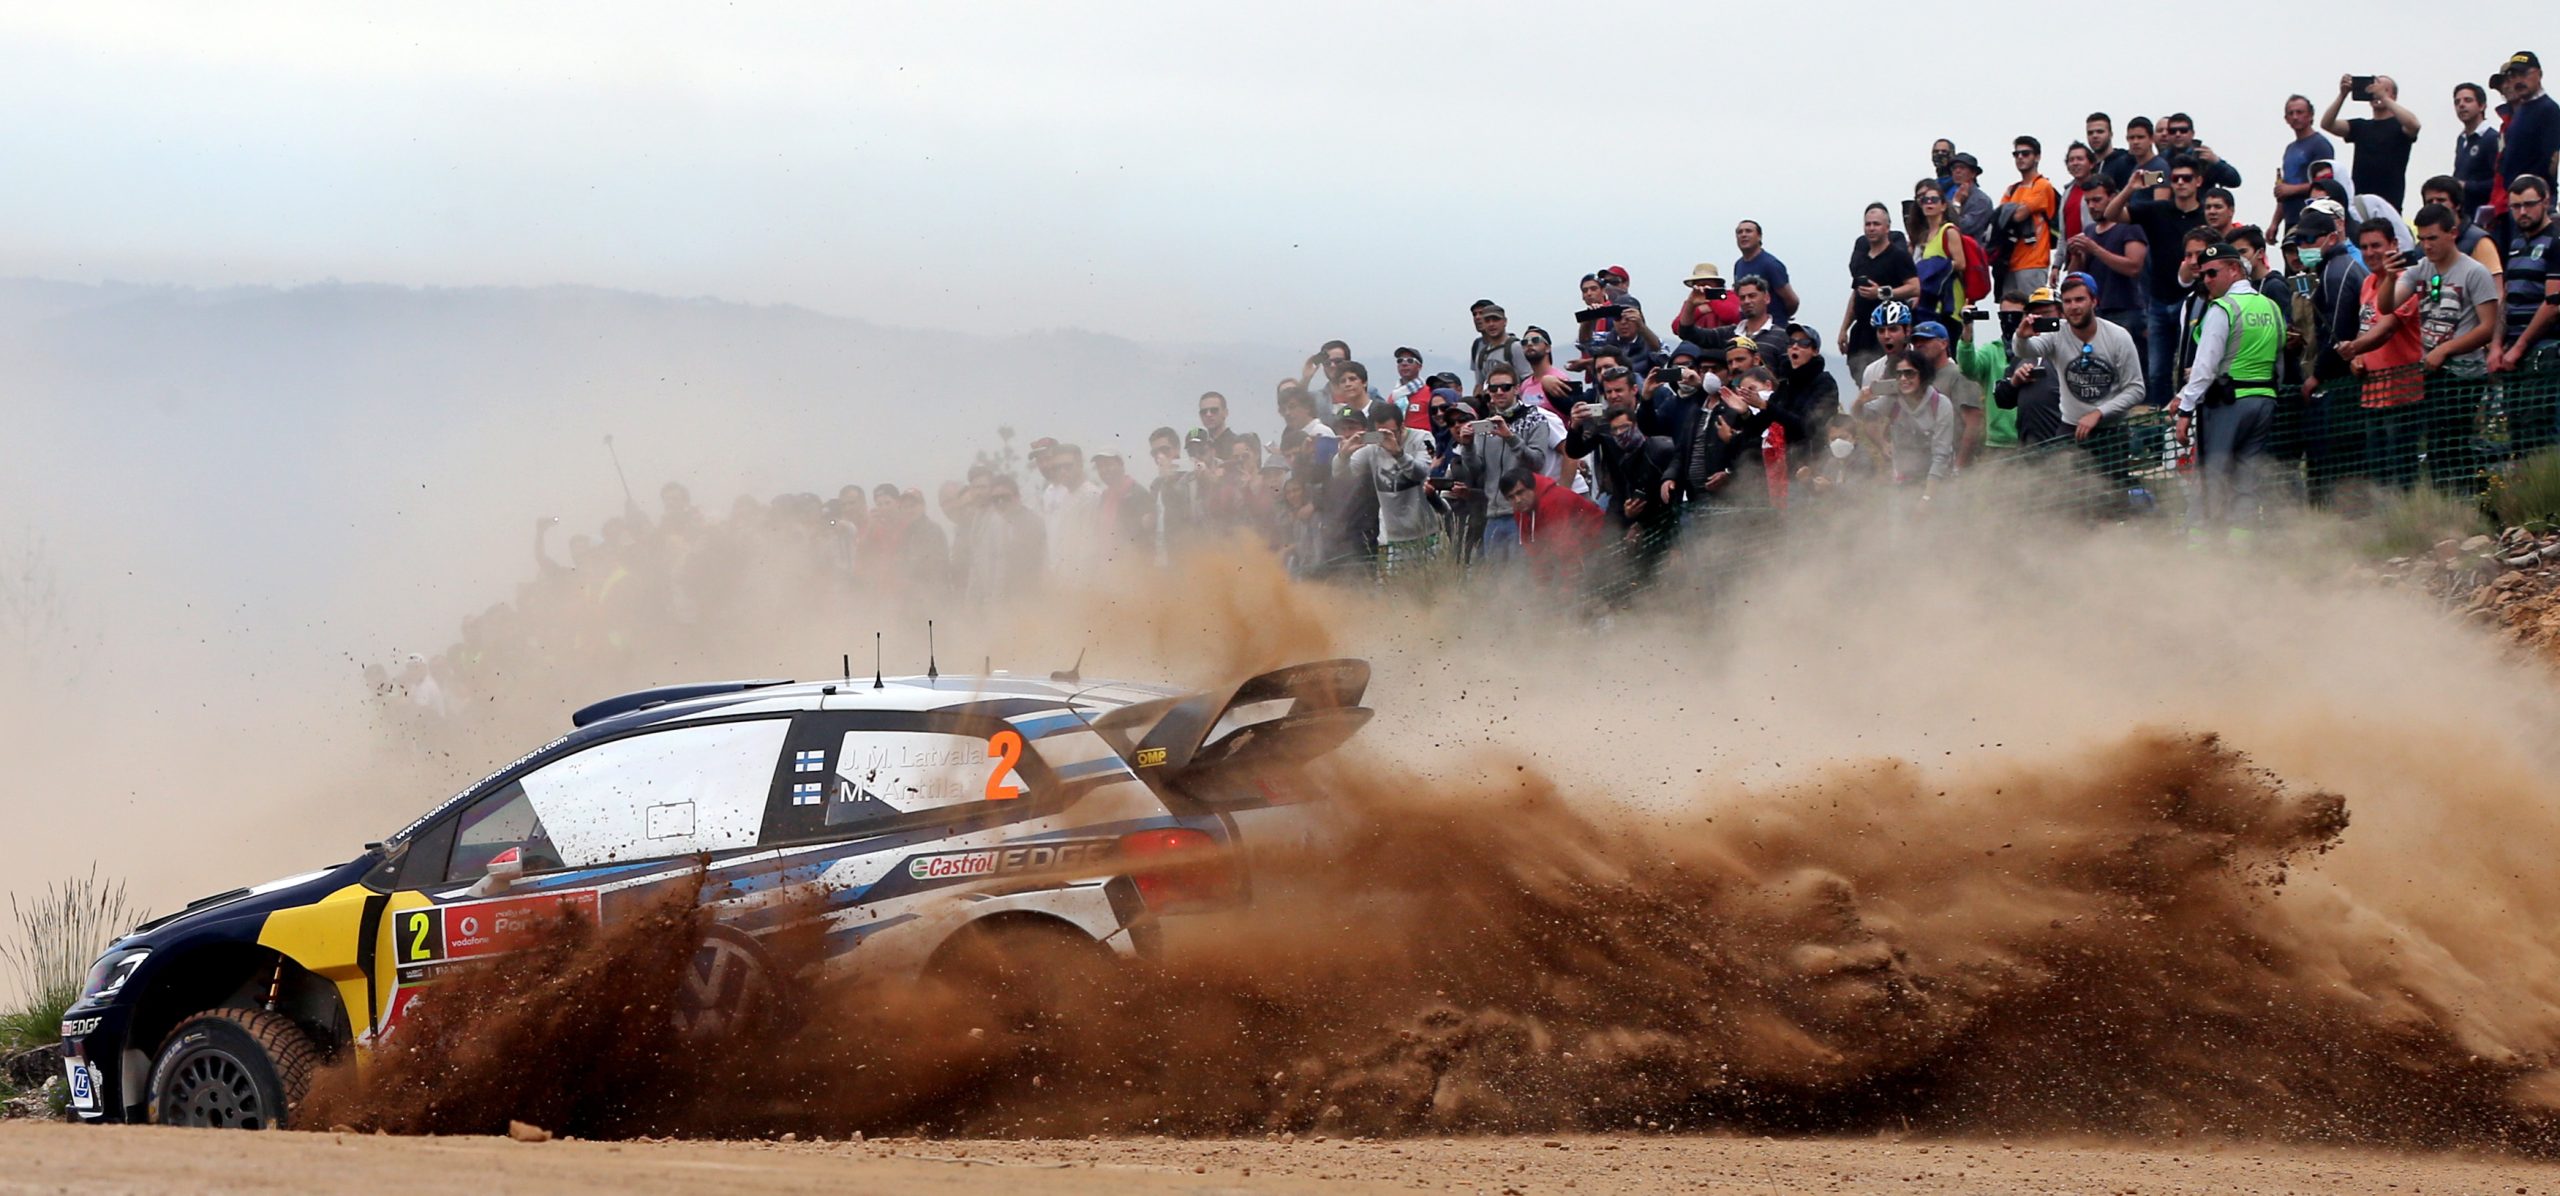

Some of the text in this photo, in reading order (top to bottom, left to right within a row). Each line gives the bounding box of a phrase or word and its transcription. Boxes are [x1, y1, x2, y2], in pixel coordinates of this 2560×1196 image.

[2245, 312, 2274, 327] GNR
[842, 743, 984, 771] J. M. Latvala
[985, 730, 1023, 800] 2
[1137, 750, 1167, 766] OMP
[396, 735, 569, 840] www.volkswagen-motorsport.com
[839, 780, 871, 803] M.
[928, 853, 994, 877] Castrol
[409, 912, 431, 961] 2
[451, 936, 490, 948] vodafone
